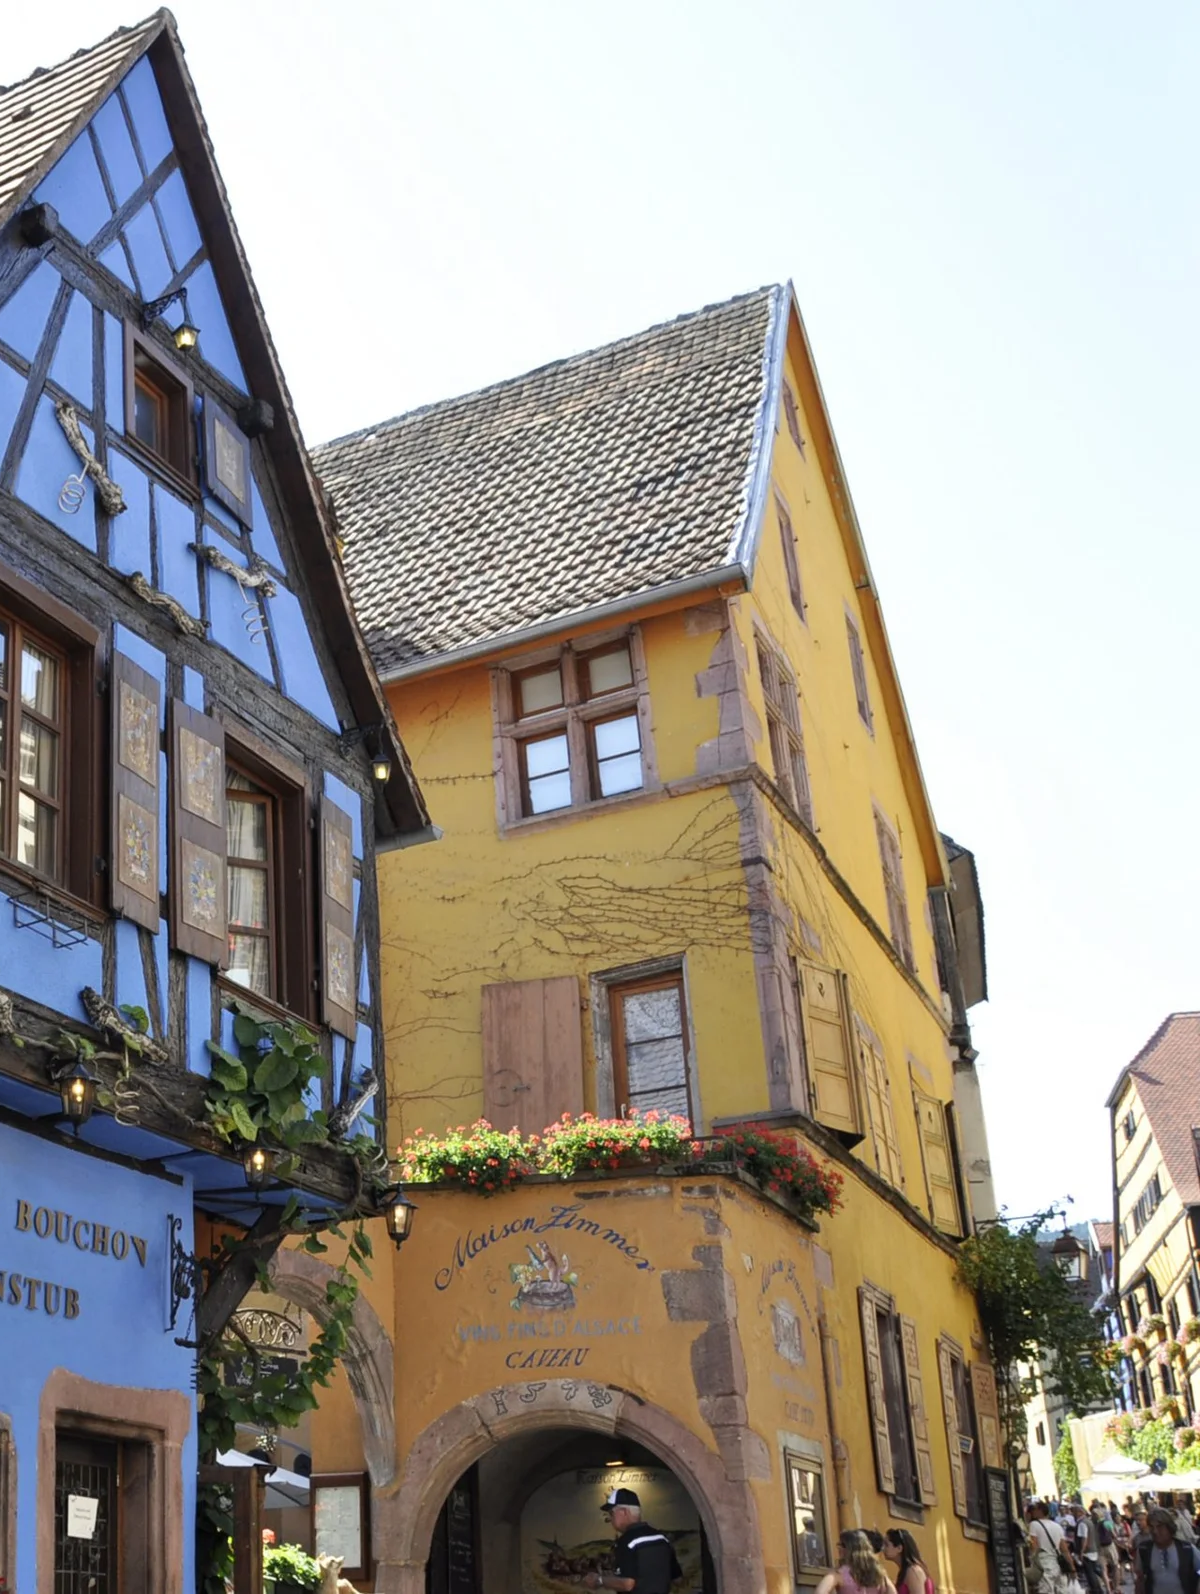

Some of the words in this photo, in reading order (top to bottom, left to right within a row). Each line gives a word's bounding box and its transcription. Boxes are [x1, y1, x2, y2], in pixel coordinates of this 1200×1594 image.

[15, 1199, 150, 1268] BOUCHON
[434, 1215, 538, 1291] Maison
[535, 1203, 655, 1273] Zimmer
[553, 1316, 644, 1339] D'ALSACE
[505, 1348, 590, 1369] CAVEAU
